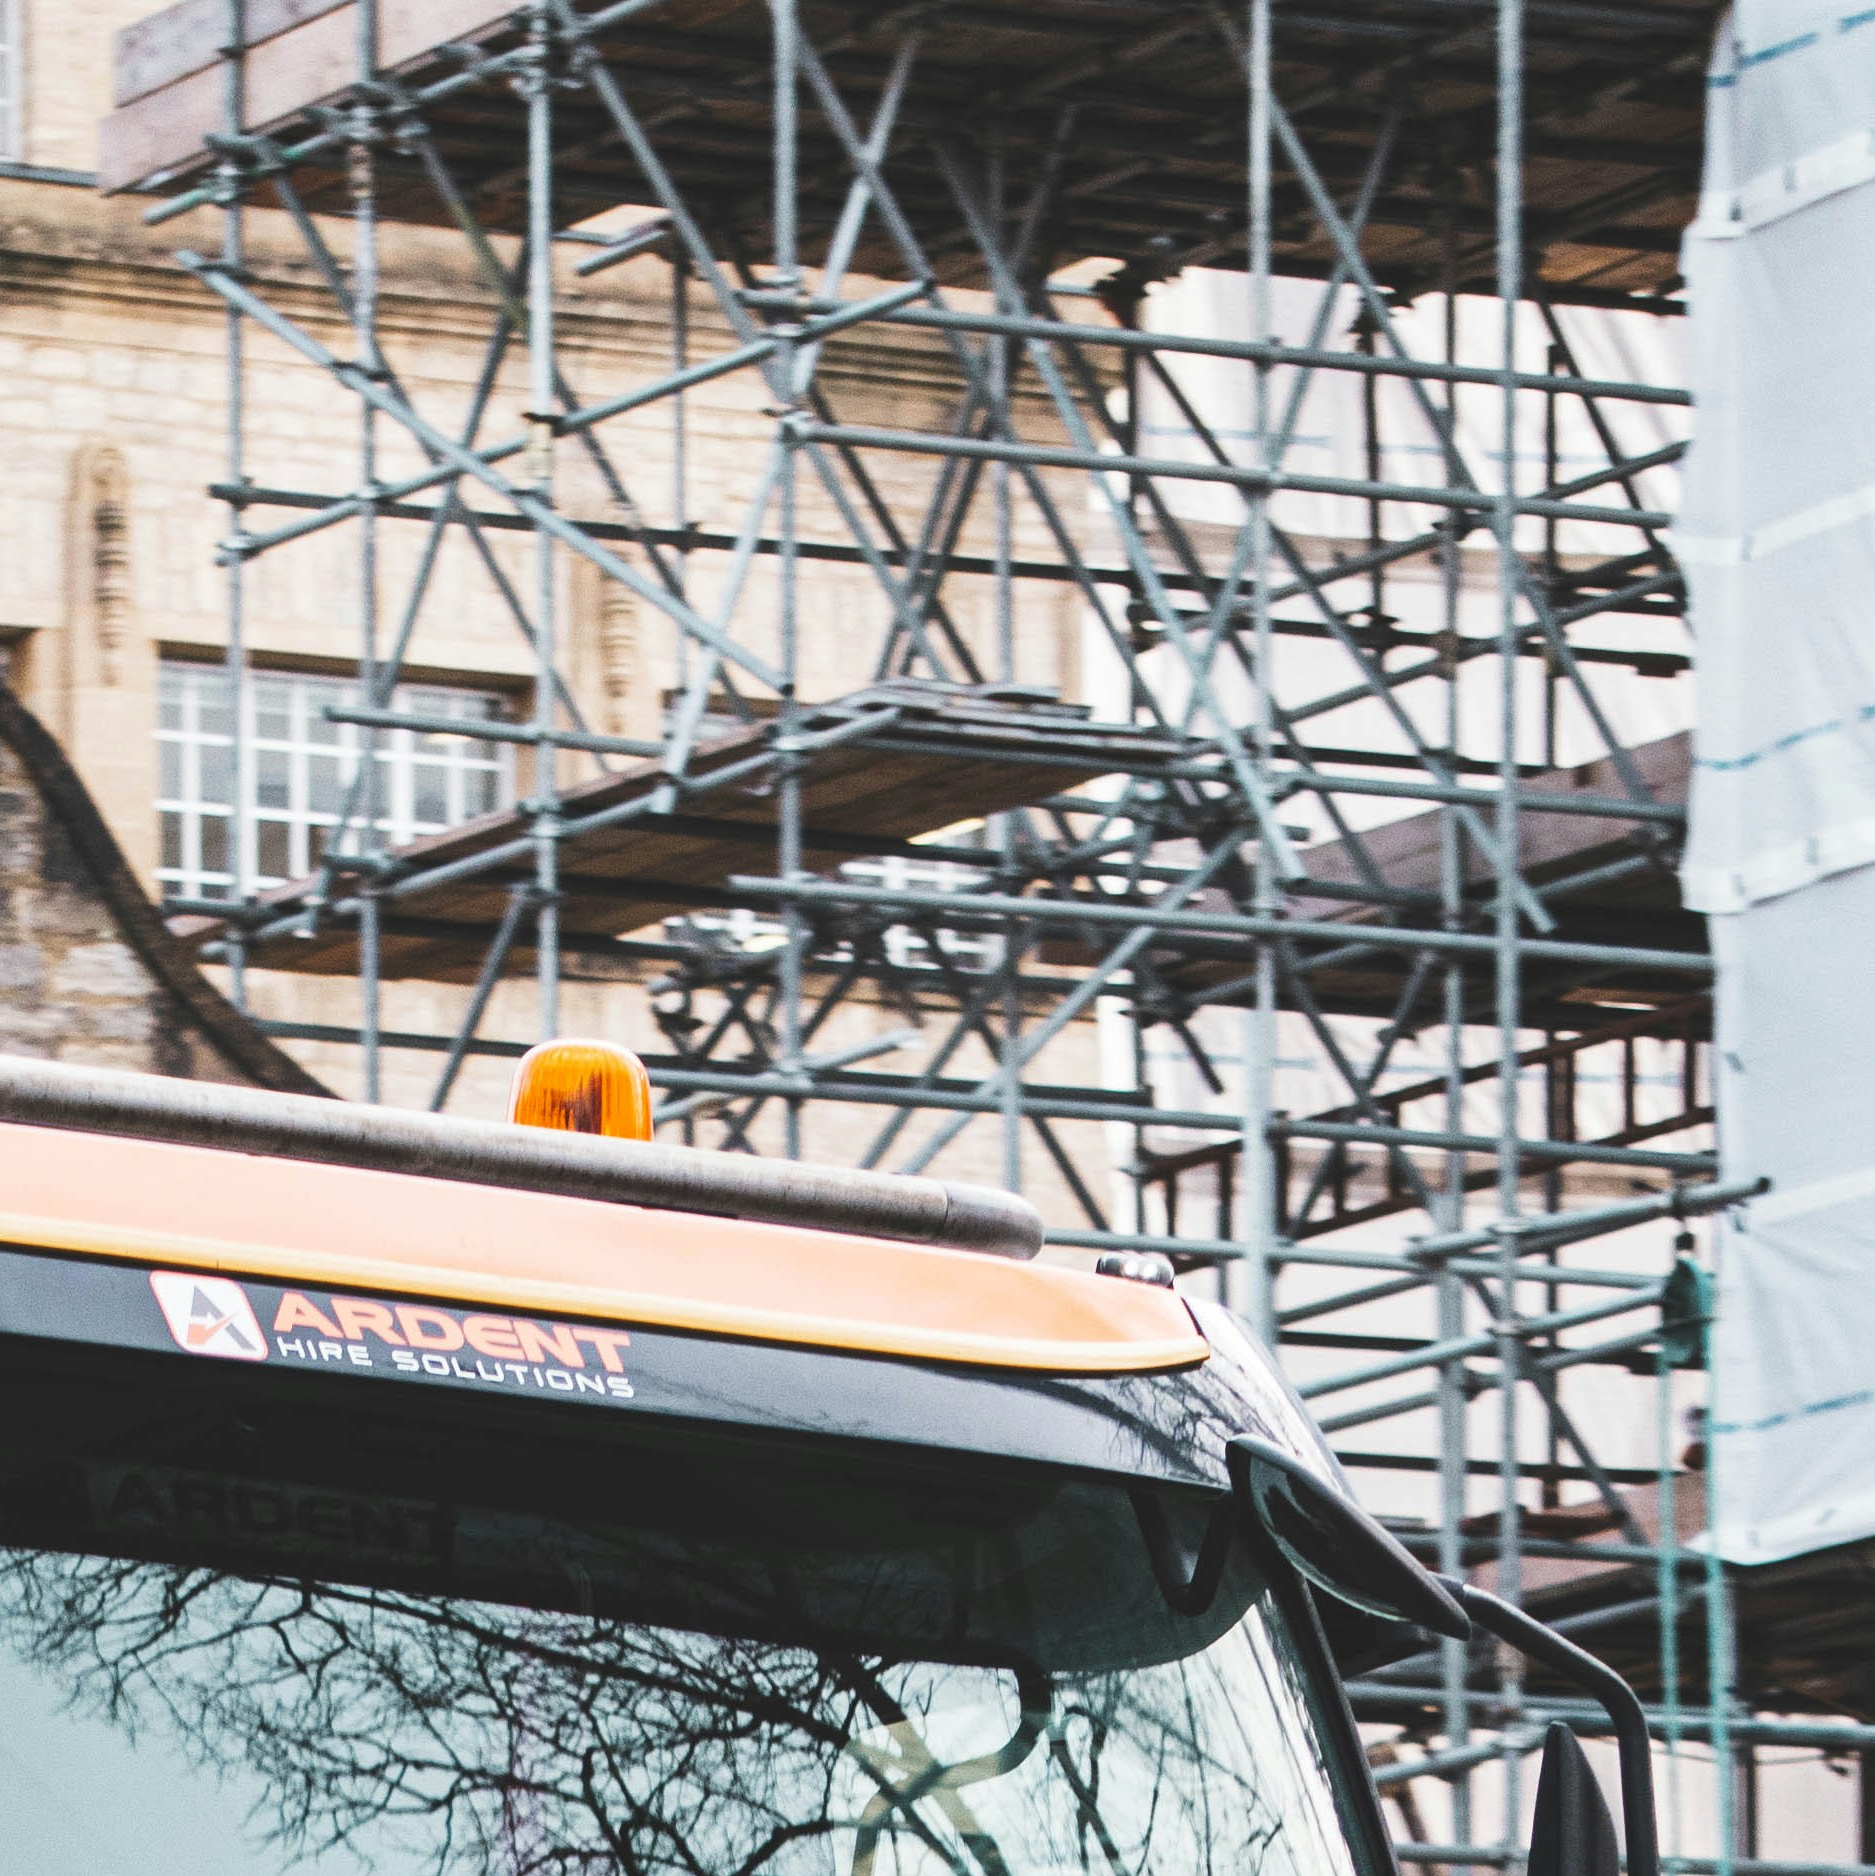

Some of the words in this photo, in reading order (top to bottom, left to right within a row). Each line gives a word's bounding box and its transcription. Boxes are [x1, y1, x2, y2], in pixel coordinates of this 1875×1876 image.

[273, 1292, 631, 1373] ARDENT
[276, 1335, 373, 1367] HIRE
[392, 1350, 635, 1398] SOLUTIONS
